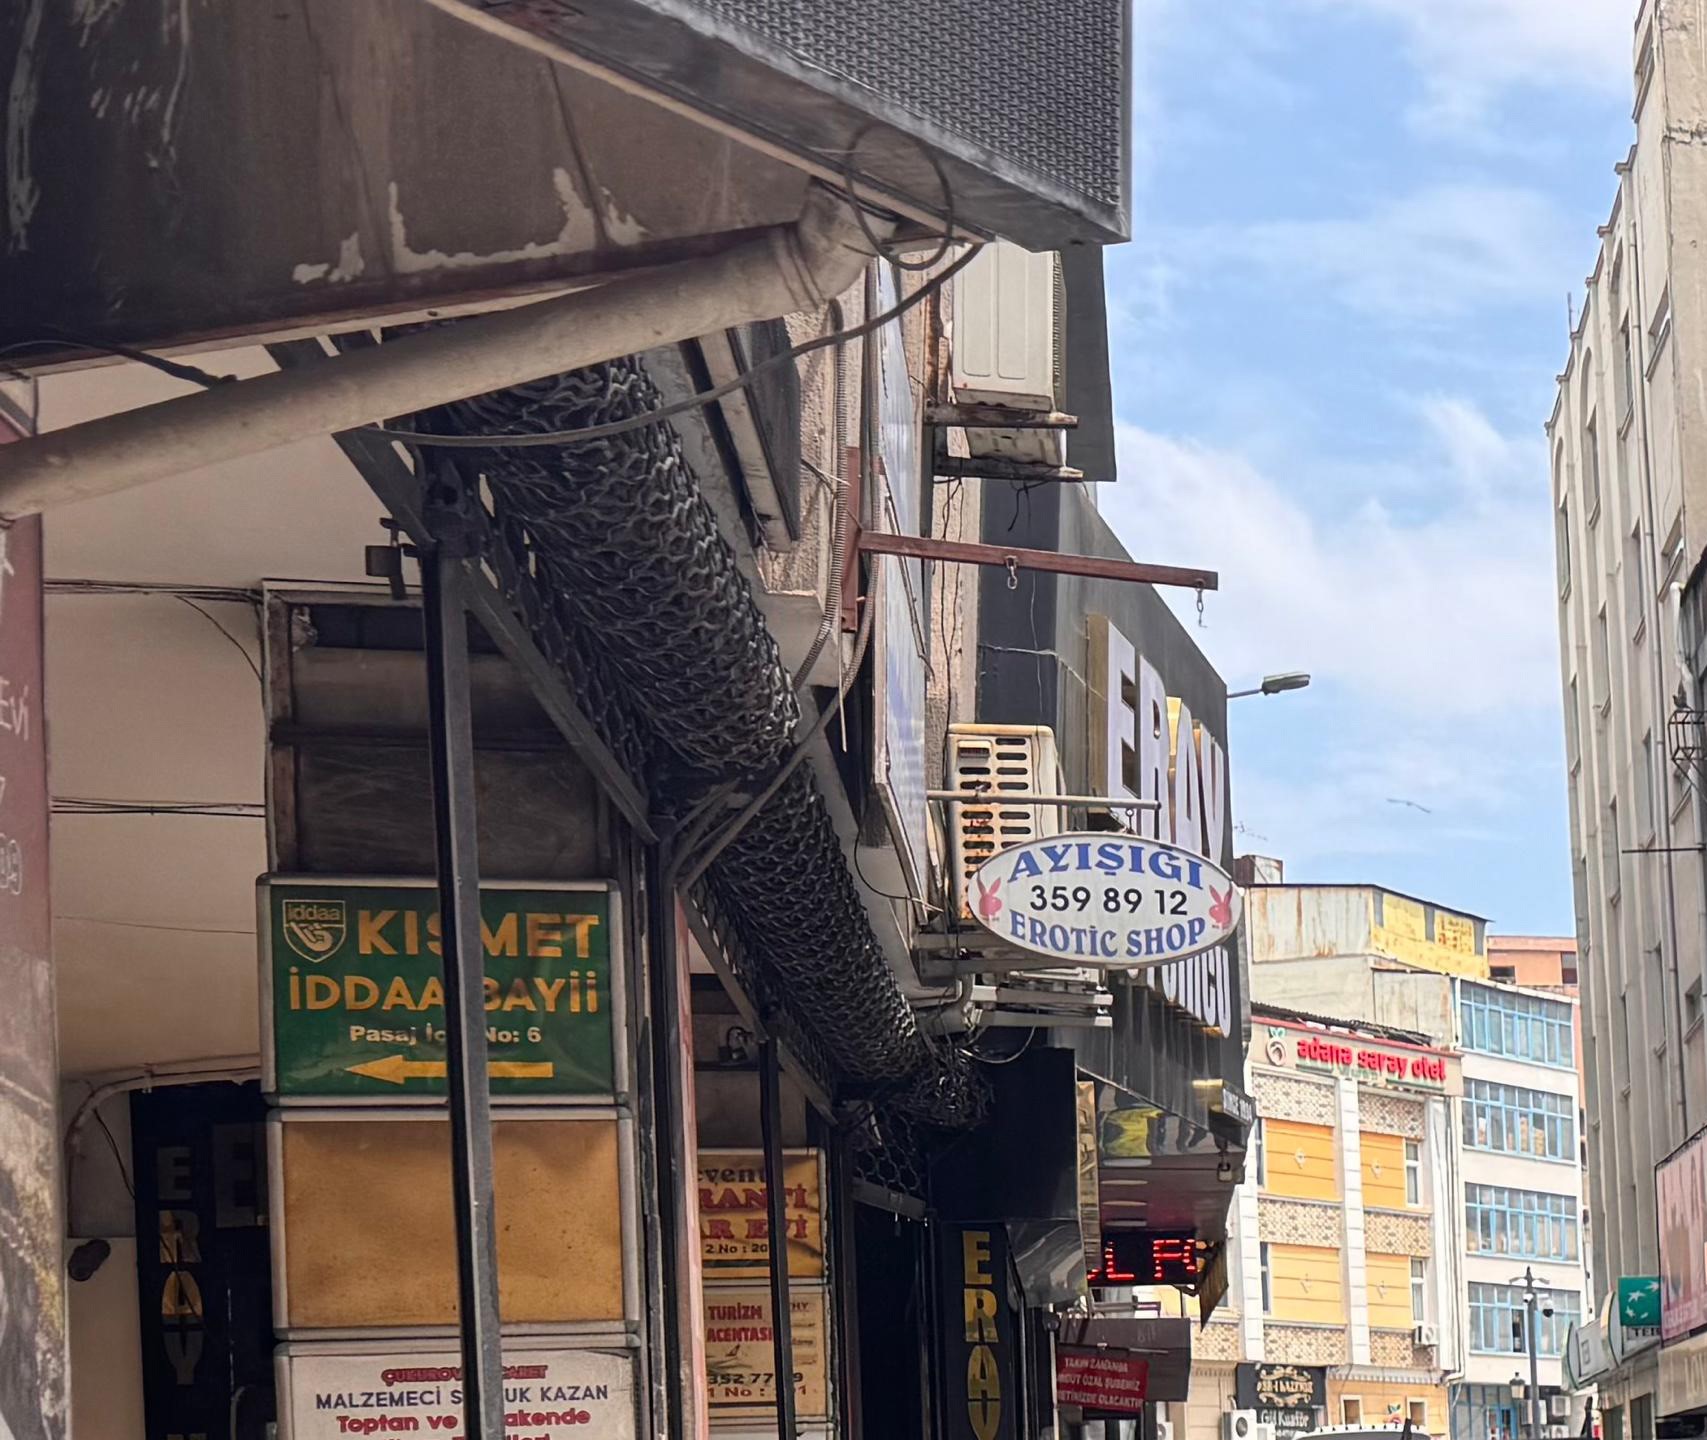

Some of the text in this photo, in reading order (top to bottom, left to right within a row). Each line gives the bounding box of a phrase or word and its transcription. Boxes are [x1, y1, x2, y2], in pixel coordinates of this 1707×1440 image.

[1030, 885, 1188, 915] 359 89 12
[1010, 909, 1205, 957] EROTİC SHOP
[350, 1026, 417, 1046] Pasaj
[527, 1027, 542, 1043] 6
[382, 1367, 463, 1386] ÇUKUROV
[316, 1388, 441, 1410] MALZEMECİ
[540, 1385, 609, 1402] KAZAN
[337, 1415, 419, 1435] Toptan
[427, 1416, 458, 1430] ve
